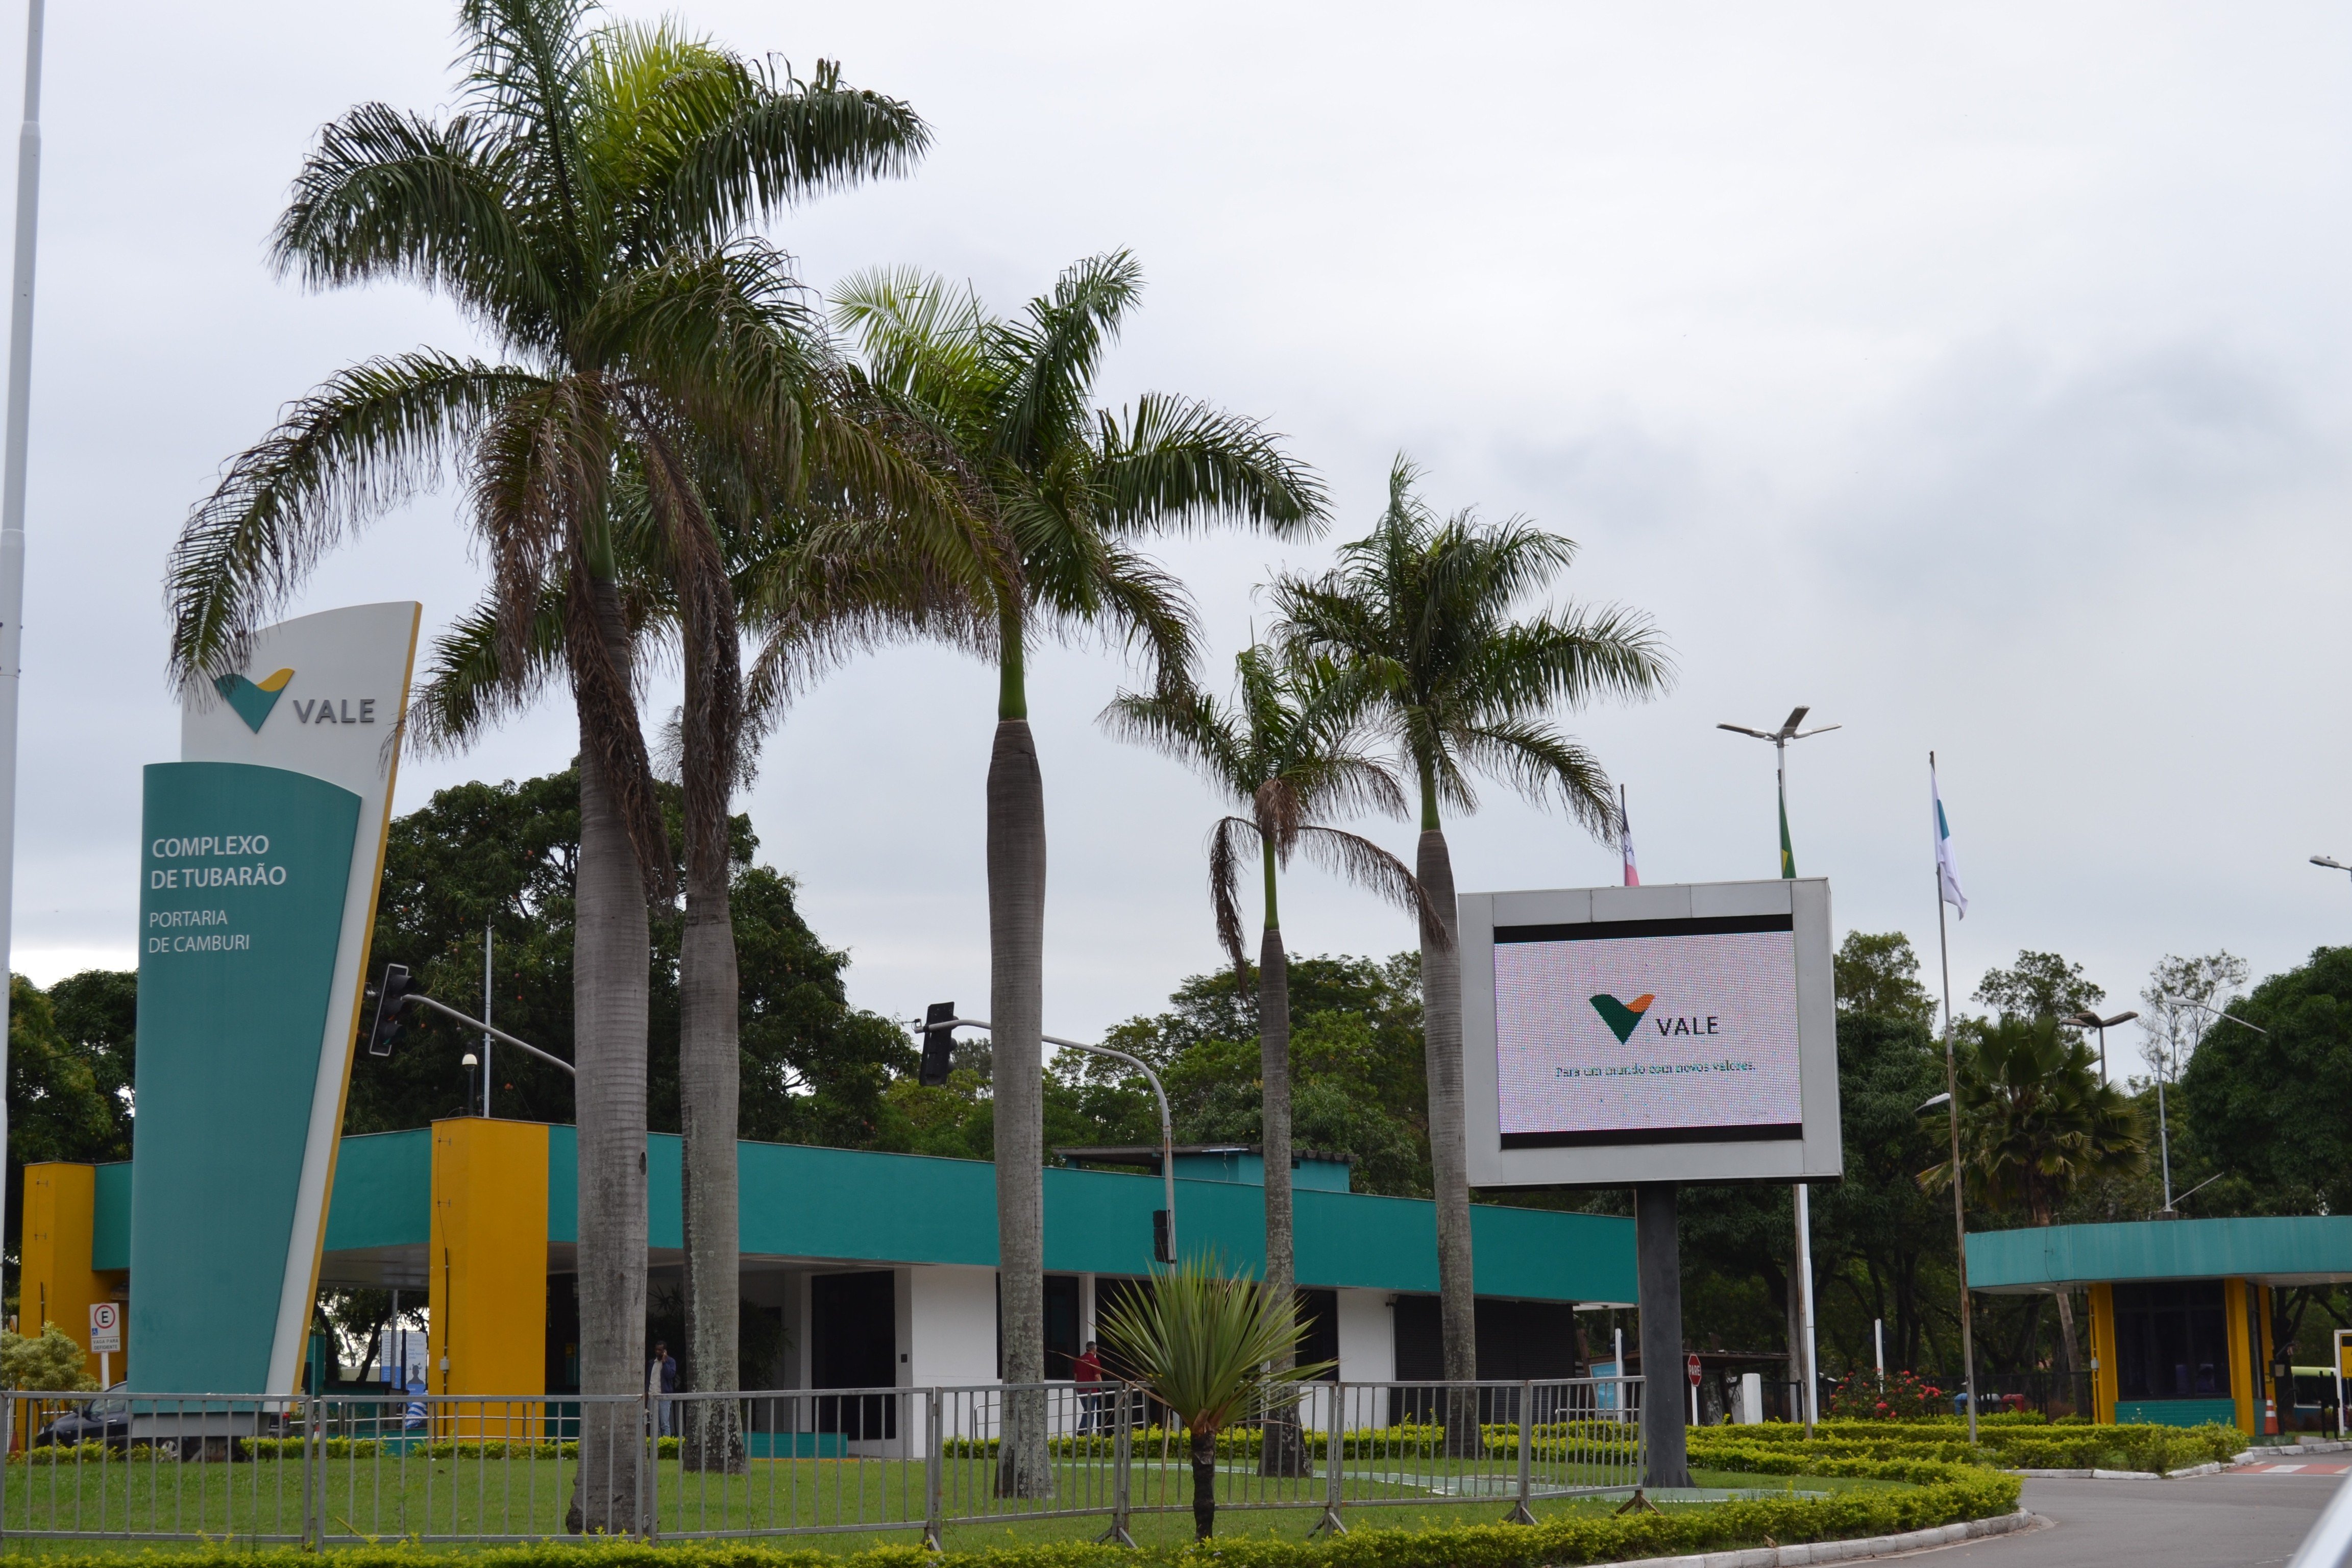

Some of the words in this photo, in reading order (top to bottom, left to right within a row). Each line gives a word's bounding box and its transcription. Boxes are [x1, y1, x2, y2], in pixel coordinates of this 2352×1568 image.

[292, 699, 375, 724] VALE
[153, 835, 269, 858] COMPLEXO
[151, 869, 178, 889] DE
[182, 863, 286, 888] TUBARÃO
[150, 910, 228, 928] PORTARIA
[149, 937, 169, 953] DE
[174, 935, 250, 952] CAMBURI
[1656, 1016, 1719, 1036] VALE
[1556, 1067, 1580, 1077] Para
[102, 1311, 109, 1323] E
[1689, 1364, 1701, 1376] PARE
